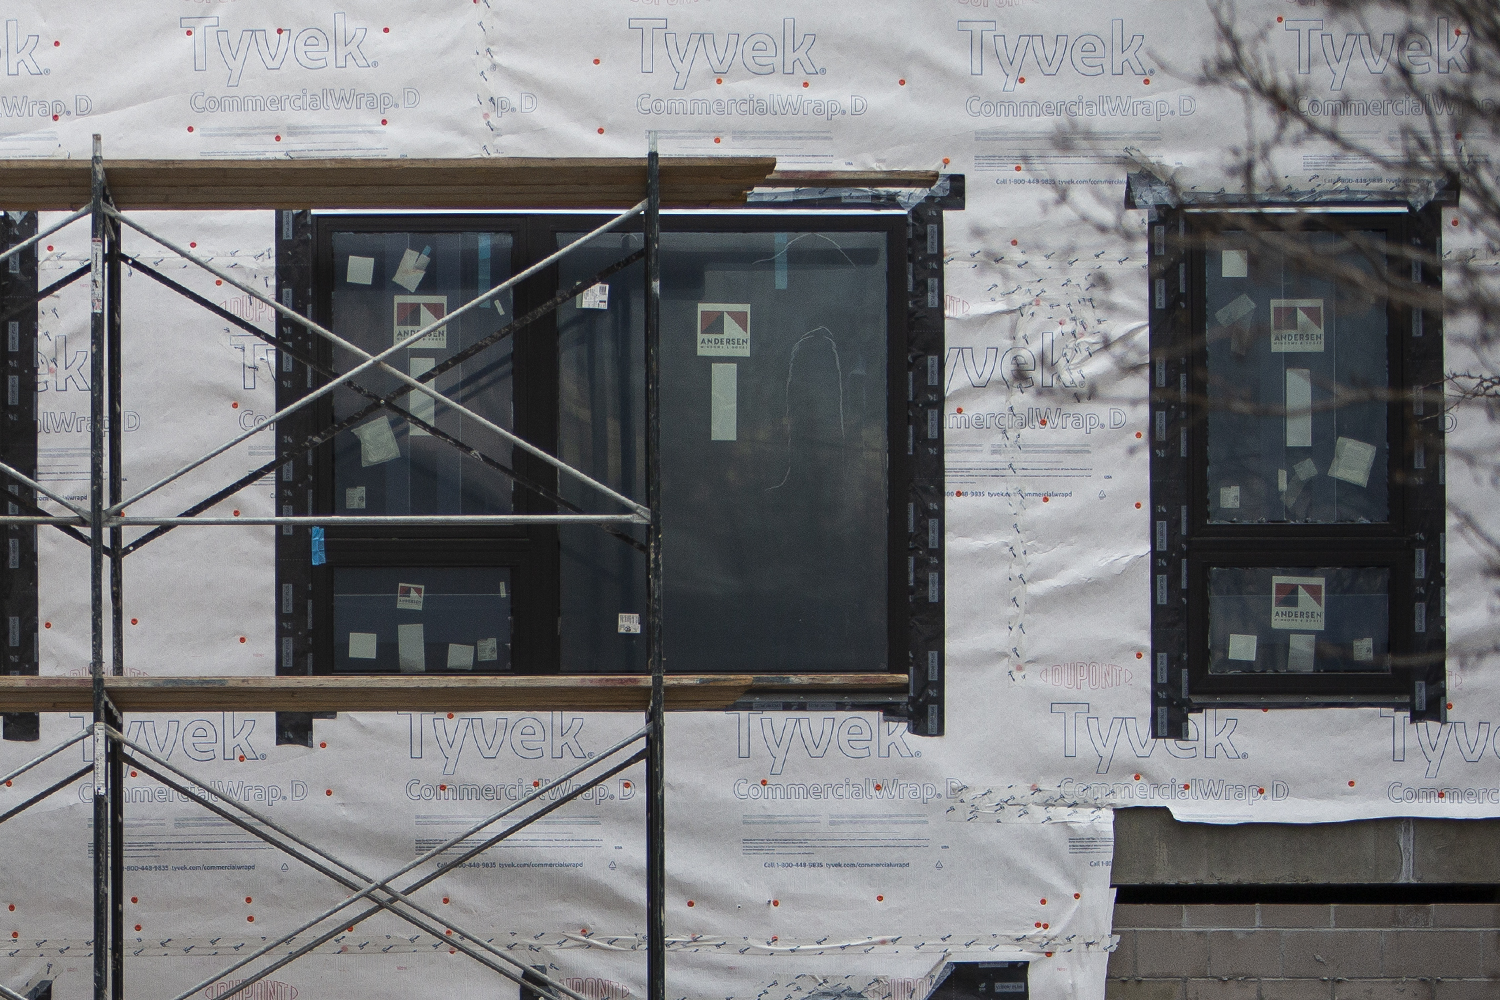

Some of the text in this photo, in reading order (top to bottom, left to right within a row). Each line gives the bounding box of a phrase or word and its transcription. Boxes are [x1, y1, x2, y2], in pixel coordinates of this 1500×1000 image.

[75, 95, 92, 116] D
[403, 88, 420, 109] D
[851, 95, 868, 116] D
[1179, 95, 1197, 117] D
[396, 329, 445, 337] ANDSEN
[1274, 333, 1323, 341] ANDERSEN
[1110, 407, 1127, 429] D
[1274, 610, 1322, 618] ANDERSEN
[1050, 662, 1124, 690] DUPONT
[291, 780, 309, 801] D
[1271, 780, 1290, 801] D
